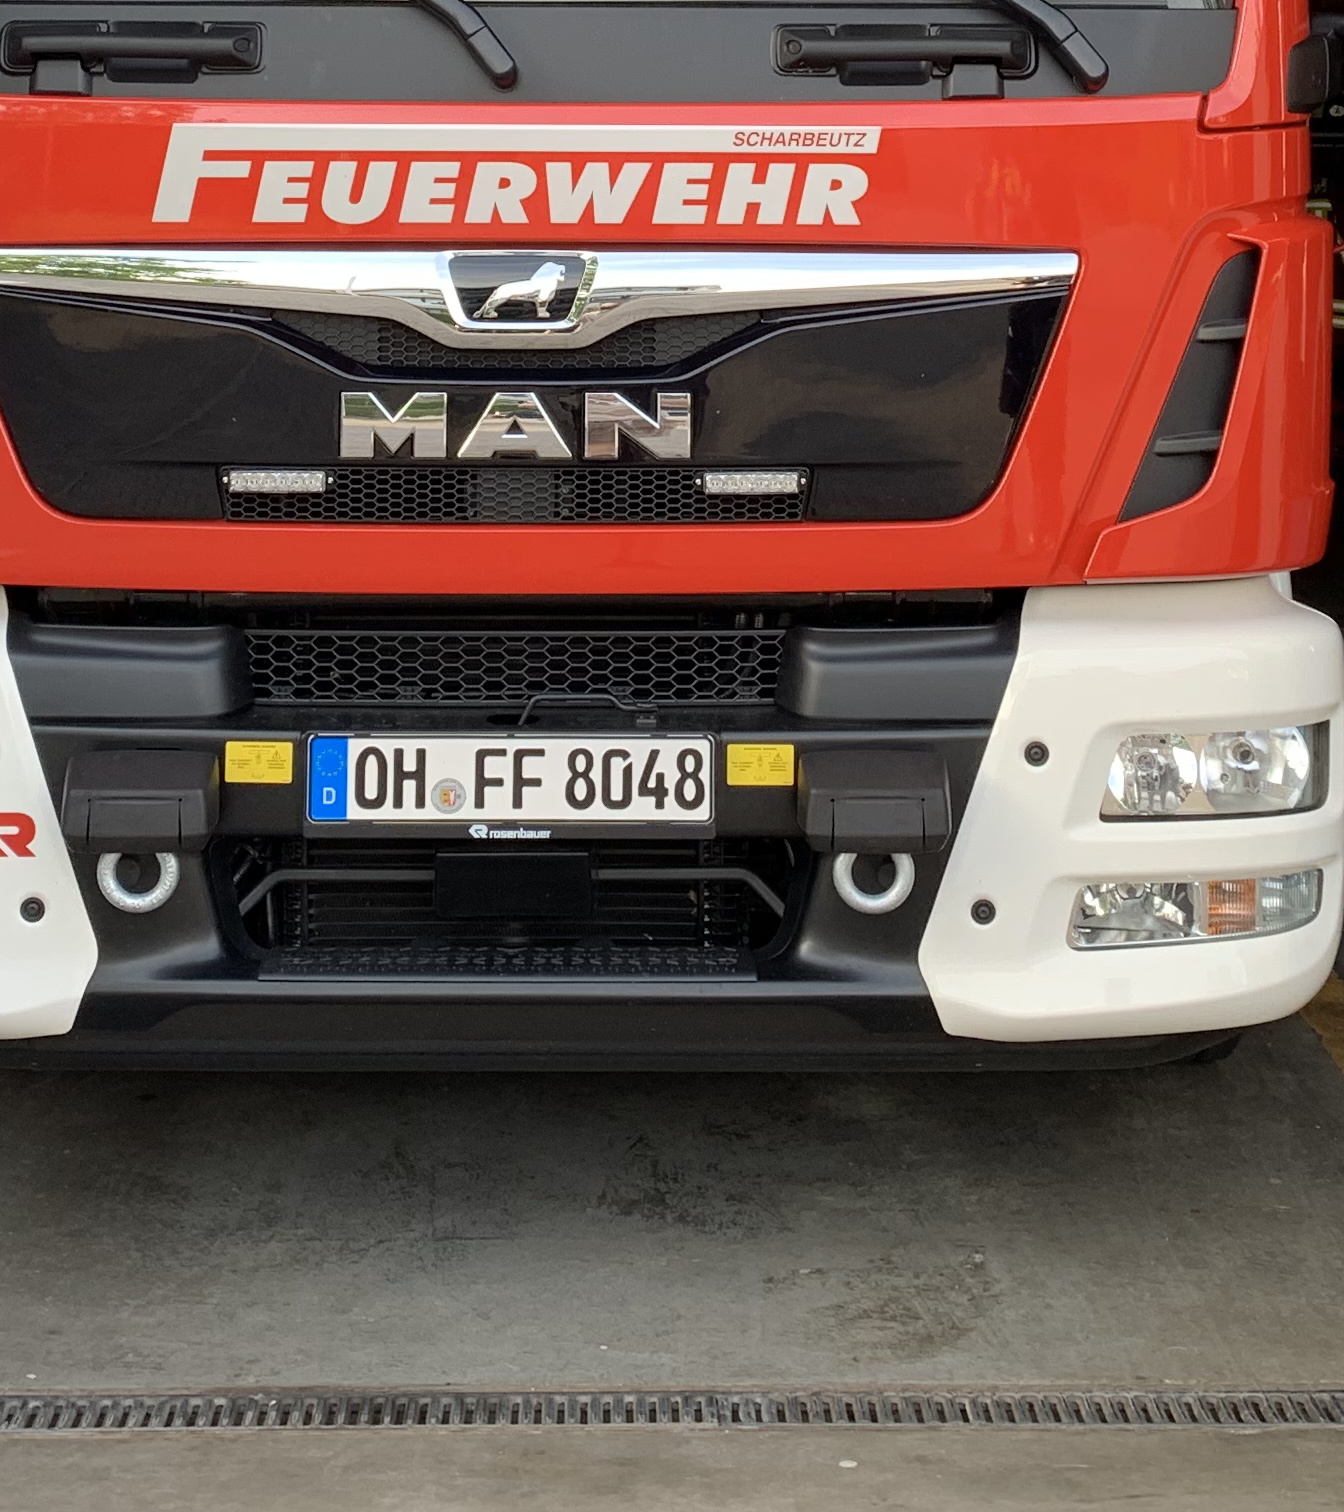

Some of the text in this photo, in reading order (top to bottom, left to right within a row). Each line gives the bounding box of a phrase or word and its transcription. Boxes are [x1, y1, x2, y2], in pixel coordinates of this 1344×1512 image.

[733, 130, 867, 149] SCHARBEUTZ
[152, 123, 868, 227] FEUERWEHR
[338, 390, 693, 461] MAN
[321, 787, 337, 806] D
[354, 745, 427, 810] OH
[473, 747, 546, 810] FF
[564, 747, 706, 812] 8048
[489, 827, 552, 840] rosenbauer
